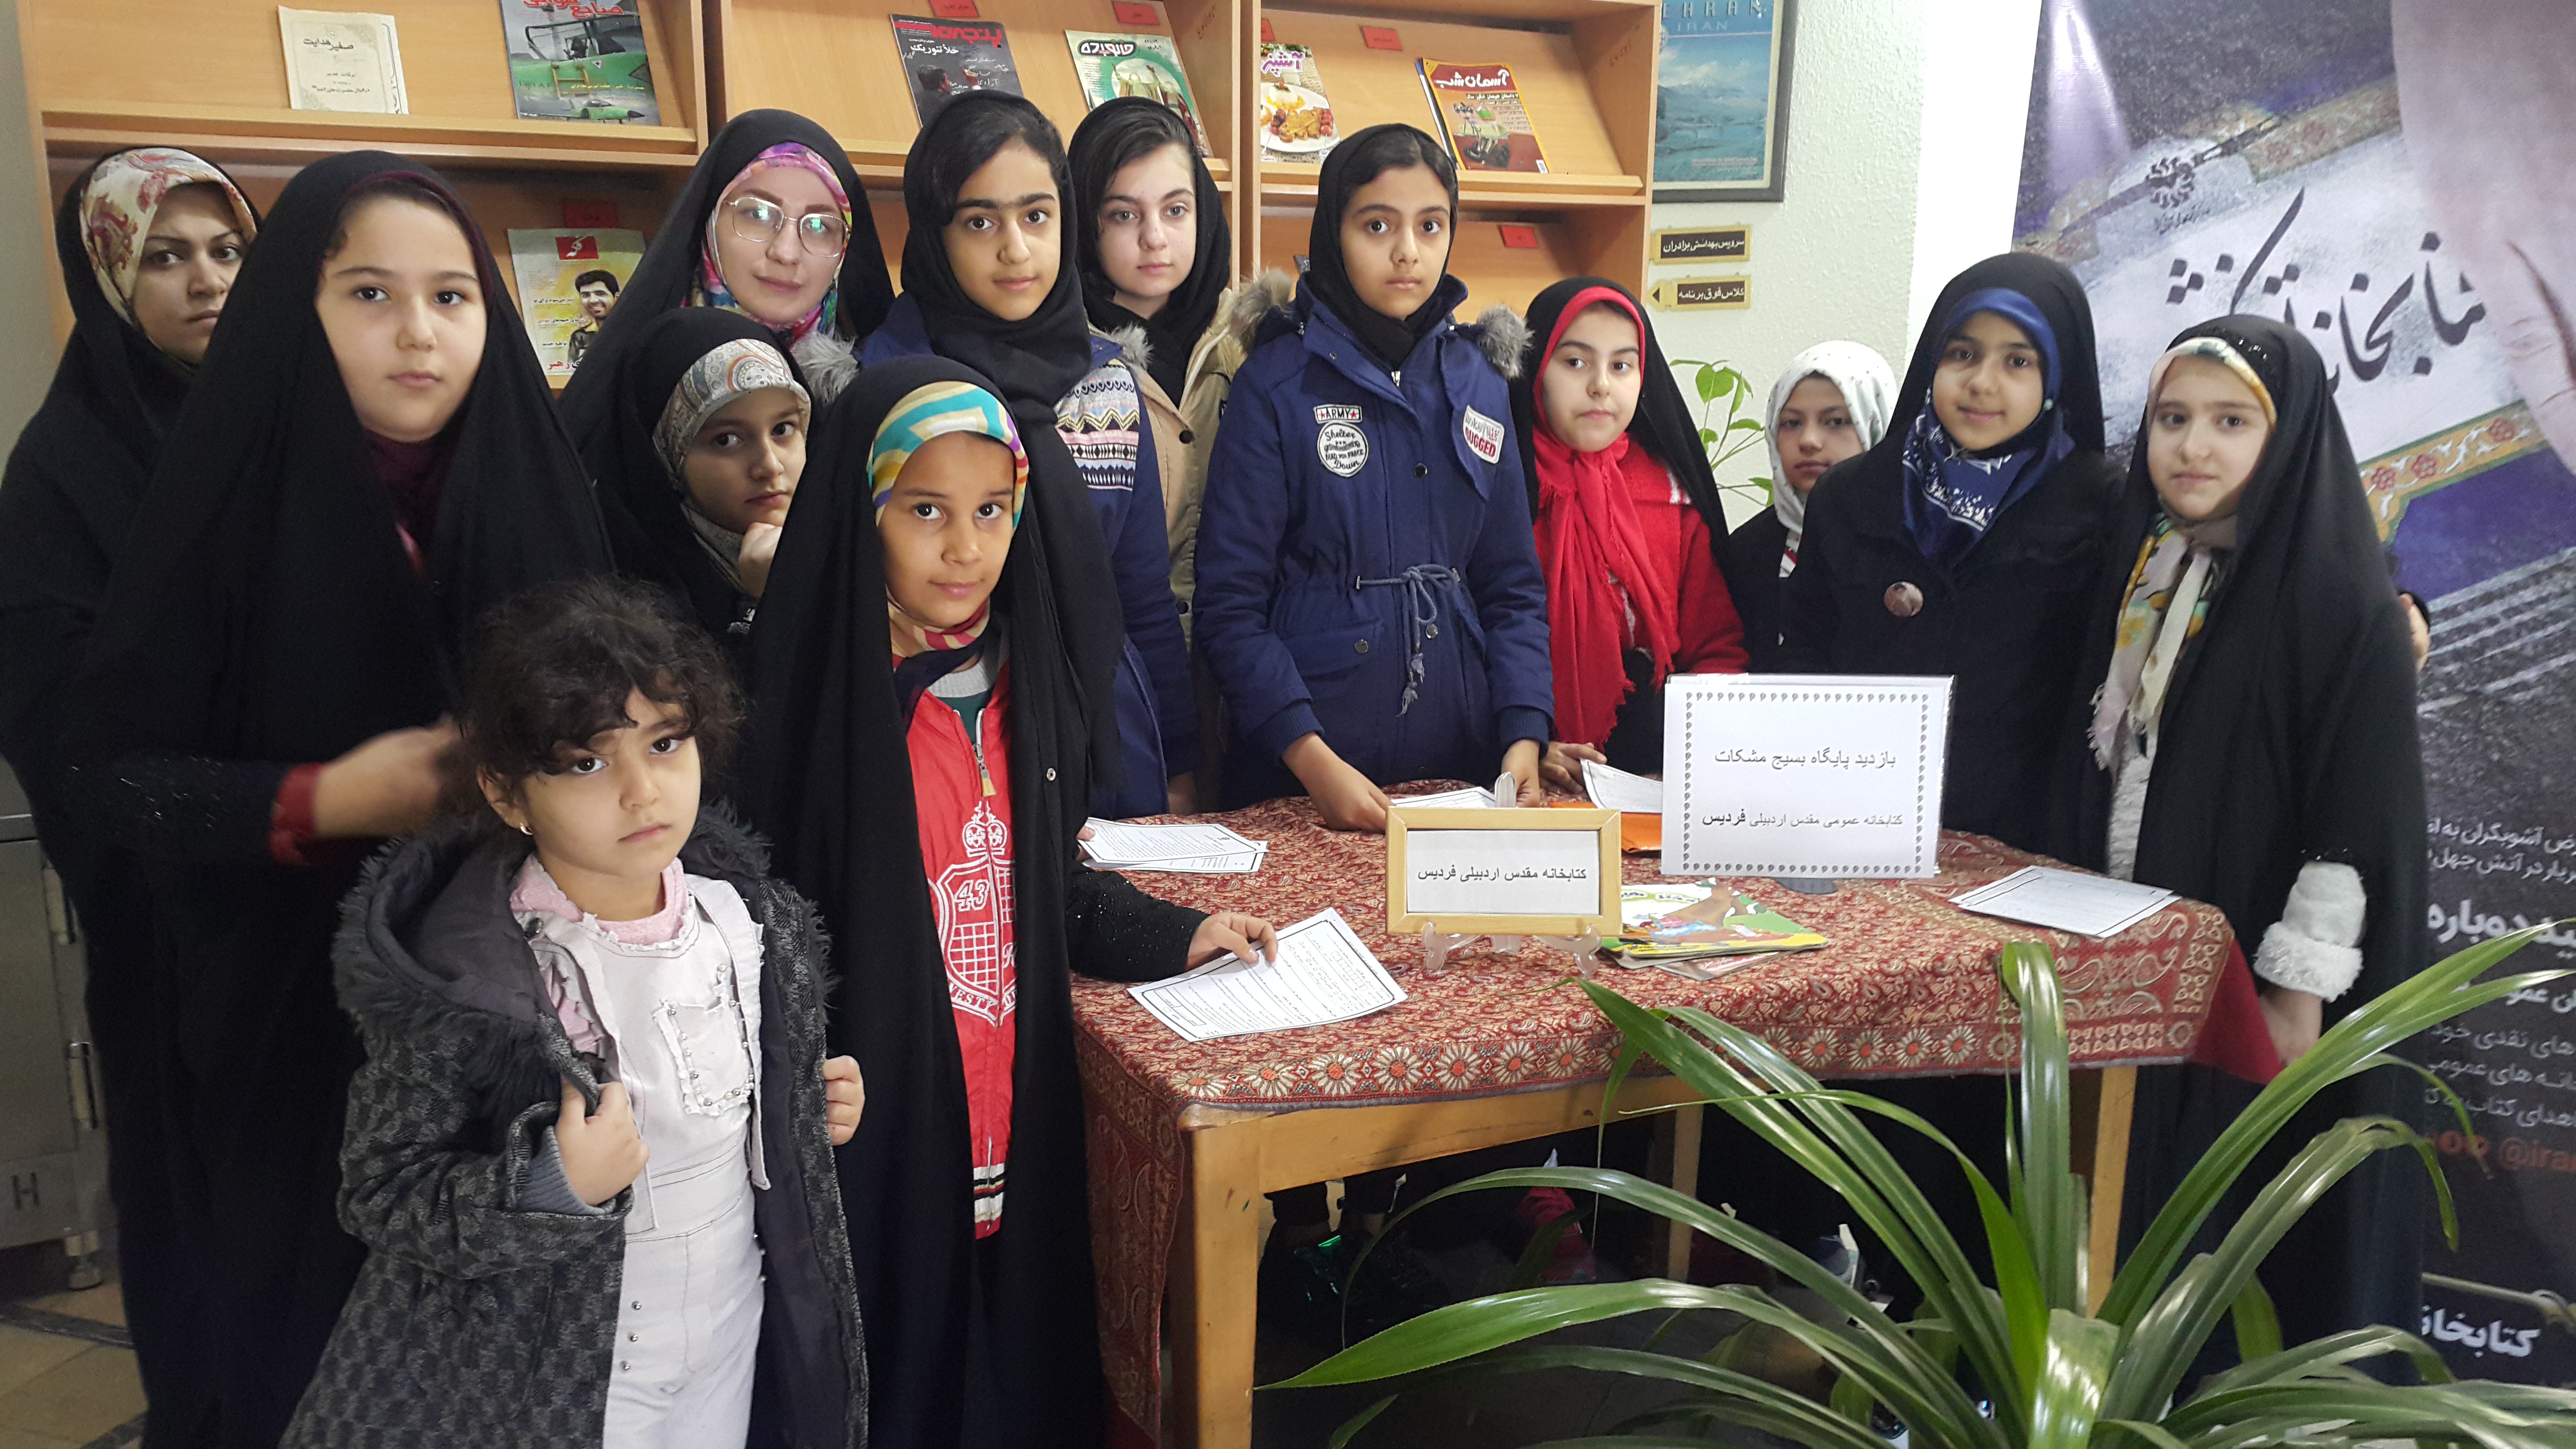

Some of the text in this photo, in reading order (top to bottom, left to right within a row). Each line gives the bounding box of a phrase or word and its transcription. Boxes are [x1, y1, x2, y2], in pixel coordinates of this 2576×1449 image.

[1662, 0, 1763, 19] EHRAN
[1677, 21, 1728, 32] IRAN
[1260, 51, 1305, 77] آشپز
[1433, 69, 1510, 89] آسمان شب
[1663, 239, 1745, 253] سرویس بهداشتی برادران
[1678, 286, 1744, 301] کلاس فوق برنامه
[1326, 407, 1350, 419] ARMY
[1325, 428, 1356, 441] Shelter
[1465, 426, 1497, 458] RUGGED
[1714, 746, 1896, 770] بازدید پایگاه بسیج مشکات
[1702, 808, 1903, 828] کتابخانه عمومی مقدس اردبیلی فردیس
[1417, 864, 1587, 882] کتابخانه مقدس اردبیلی فردیس
[954, 879, 990, 912] 43
[2498, 1137, 2576, 1171] @ira
[2420, 1304, 2542, 1358] کتابخان
